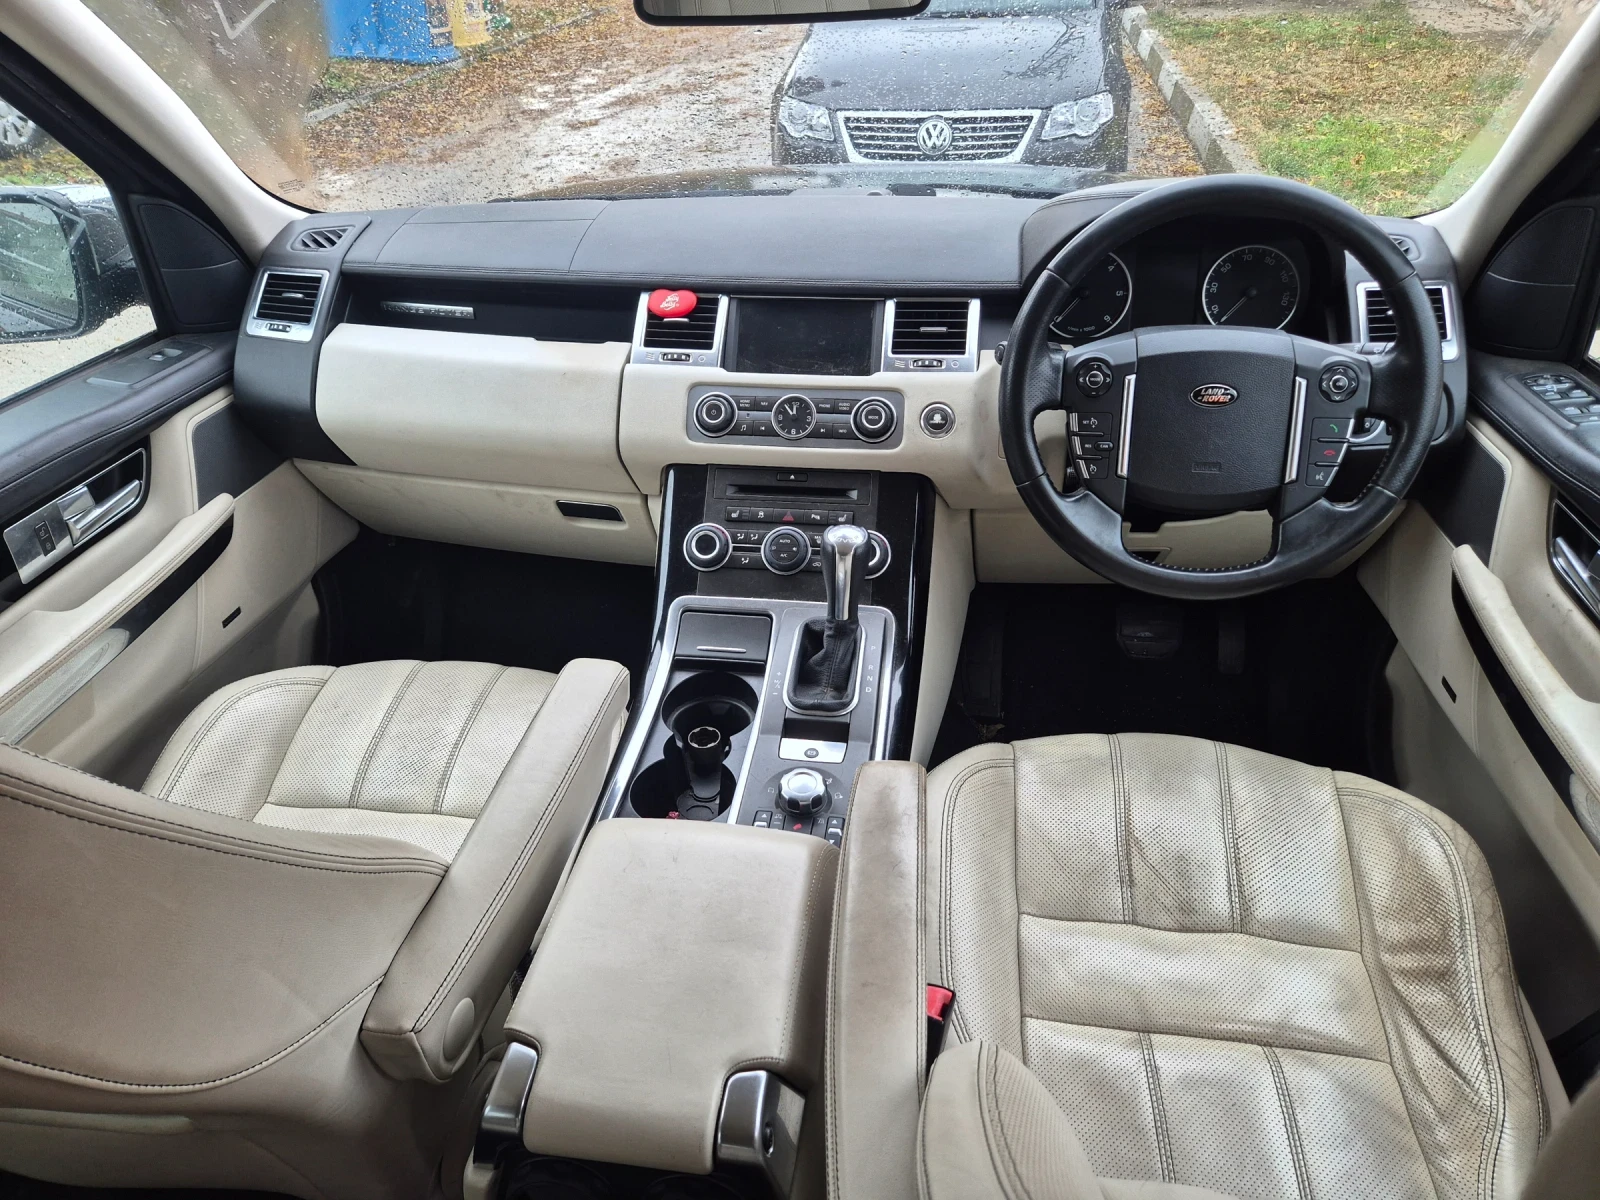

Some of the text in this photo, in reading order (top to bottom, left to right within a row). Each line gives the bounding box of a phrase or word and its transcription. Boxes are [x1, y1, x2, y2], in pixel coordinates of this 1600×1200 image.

[1264, 256, 1276, 266] 90
[1220, 263, 1232, 273] 50
[1280, 270, 1289, 283] 110
[1210, 282, 1218, 293] 30
[1281, 291, 1290, 306] 130
[1211, 304, 1219, 315] 10
[1103, 314, 1111, 323] 6
